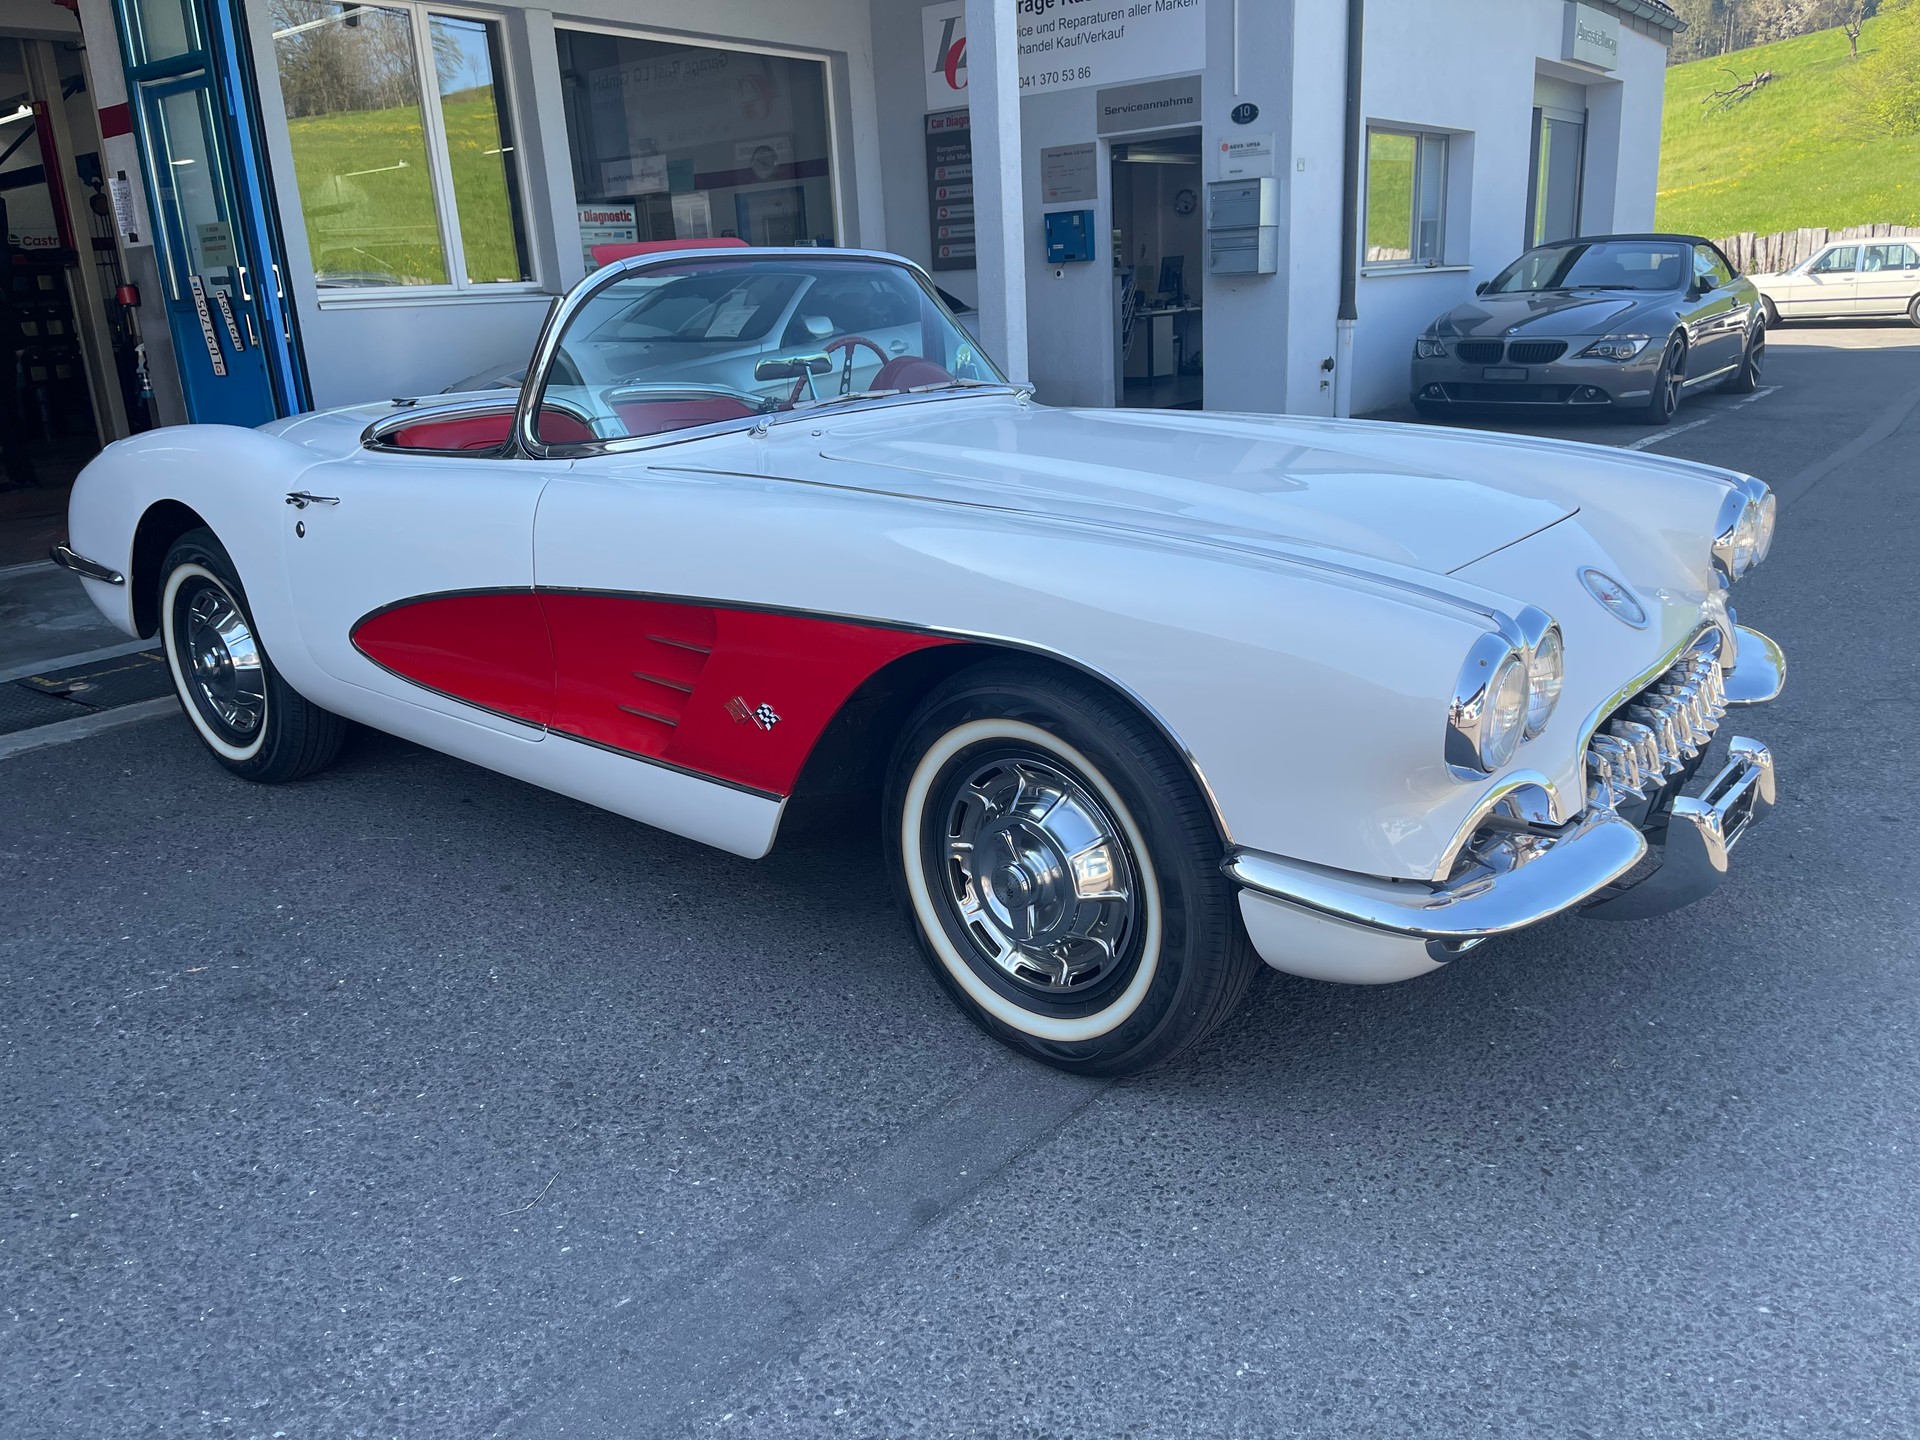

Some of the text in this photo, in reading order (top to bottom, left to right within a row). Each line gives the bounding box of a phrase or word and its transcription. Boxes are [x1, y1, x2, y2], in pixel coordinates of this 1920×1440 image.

[1016, 25, 1033, 37] ice
[1036, 20, 1055, 34] und
[1058, 10, 1124, 30] Reparaturen
[1128, 4, 1151, 17] aller
[1018, 25, 1125, 55] handel Kauf/Verkauf
[1018, 66, 1091, 88] 041 370 53 86
[1104, 96, 1193, 115] Serviceannahme
[1239, 105, 1251, 117] 10
[931, 119, 944, 129] Car
[583, 210, 632, 224] Diagnostic
